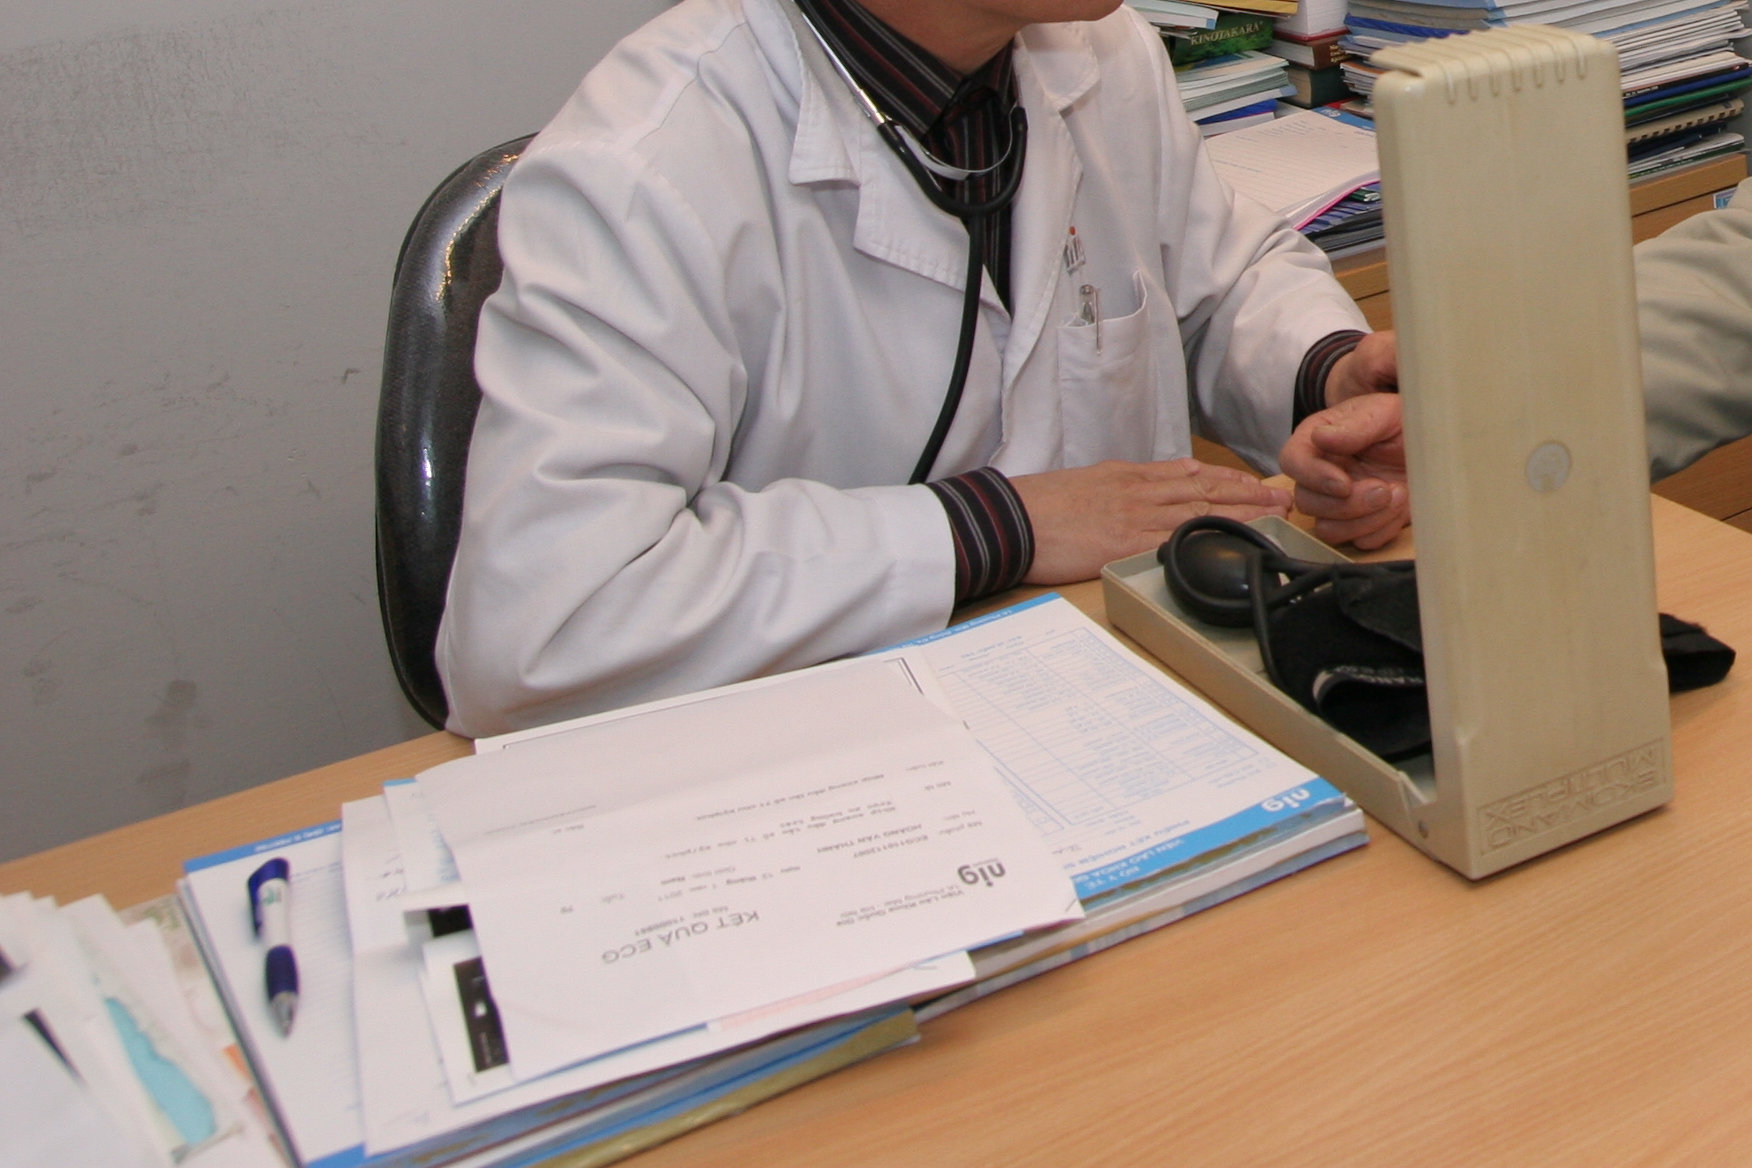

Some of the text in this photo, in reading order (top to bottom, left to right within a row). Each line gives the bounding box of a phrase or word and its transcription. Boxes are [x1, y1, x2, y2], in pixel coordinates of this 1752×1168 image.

[1190, 23, 1260, 46] KINOTAKARA
[1260, 786, 1311, 815] nig
[1481, 747, 1659, 827] MULTIPLEX
[956, 856, 1006, 892] nig
[599, 908, 759, 965] KẾT QUẢ ECG
